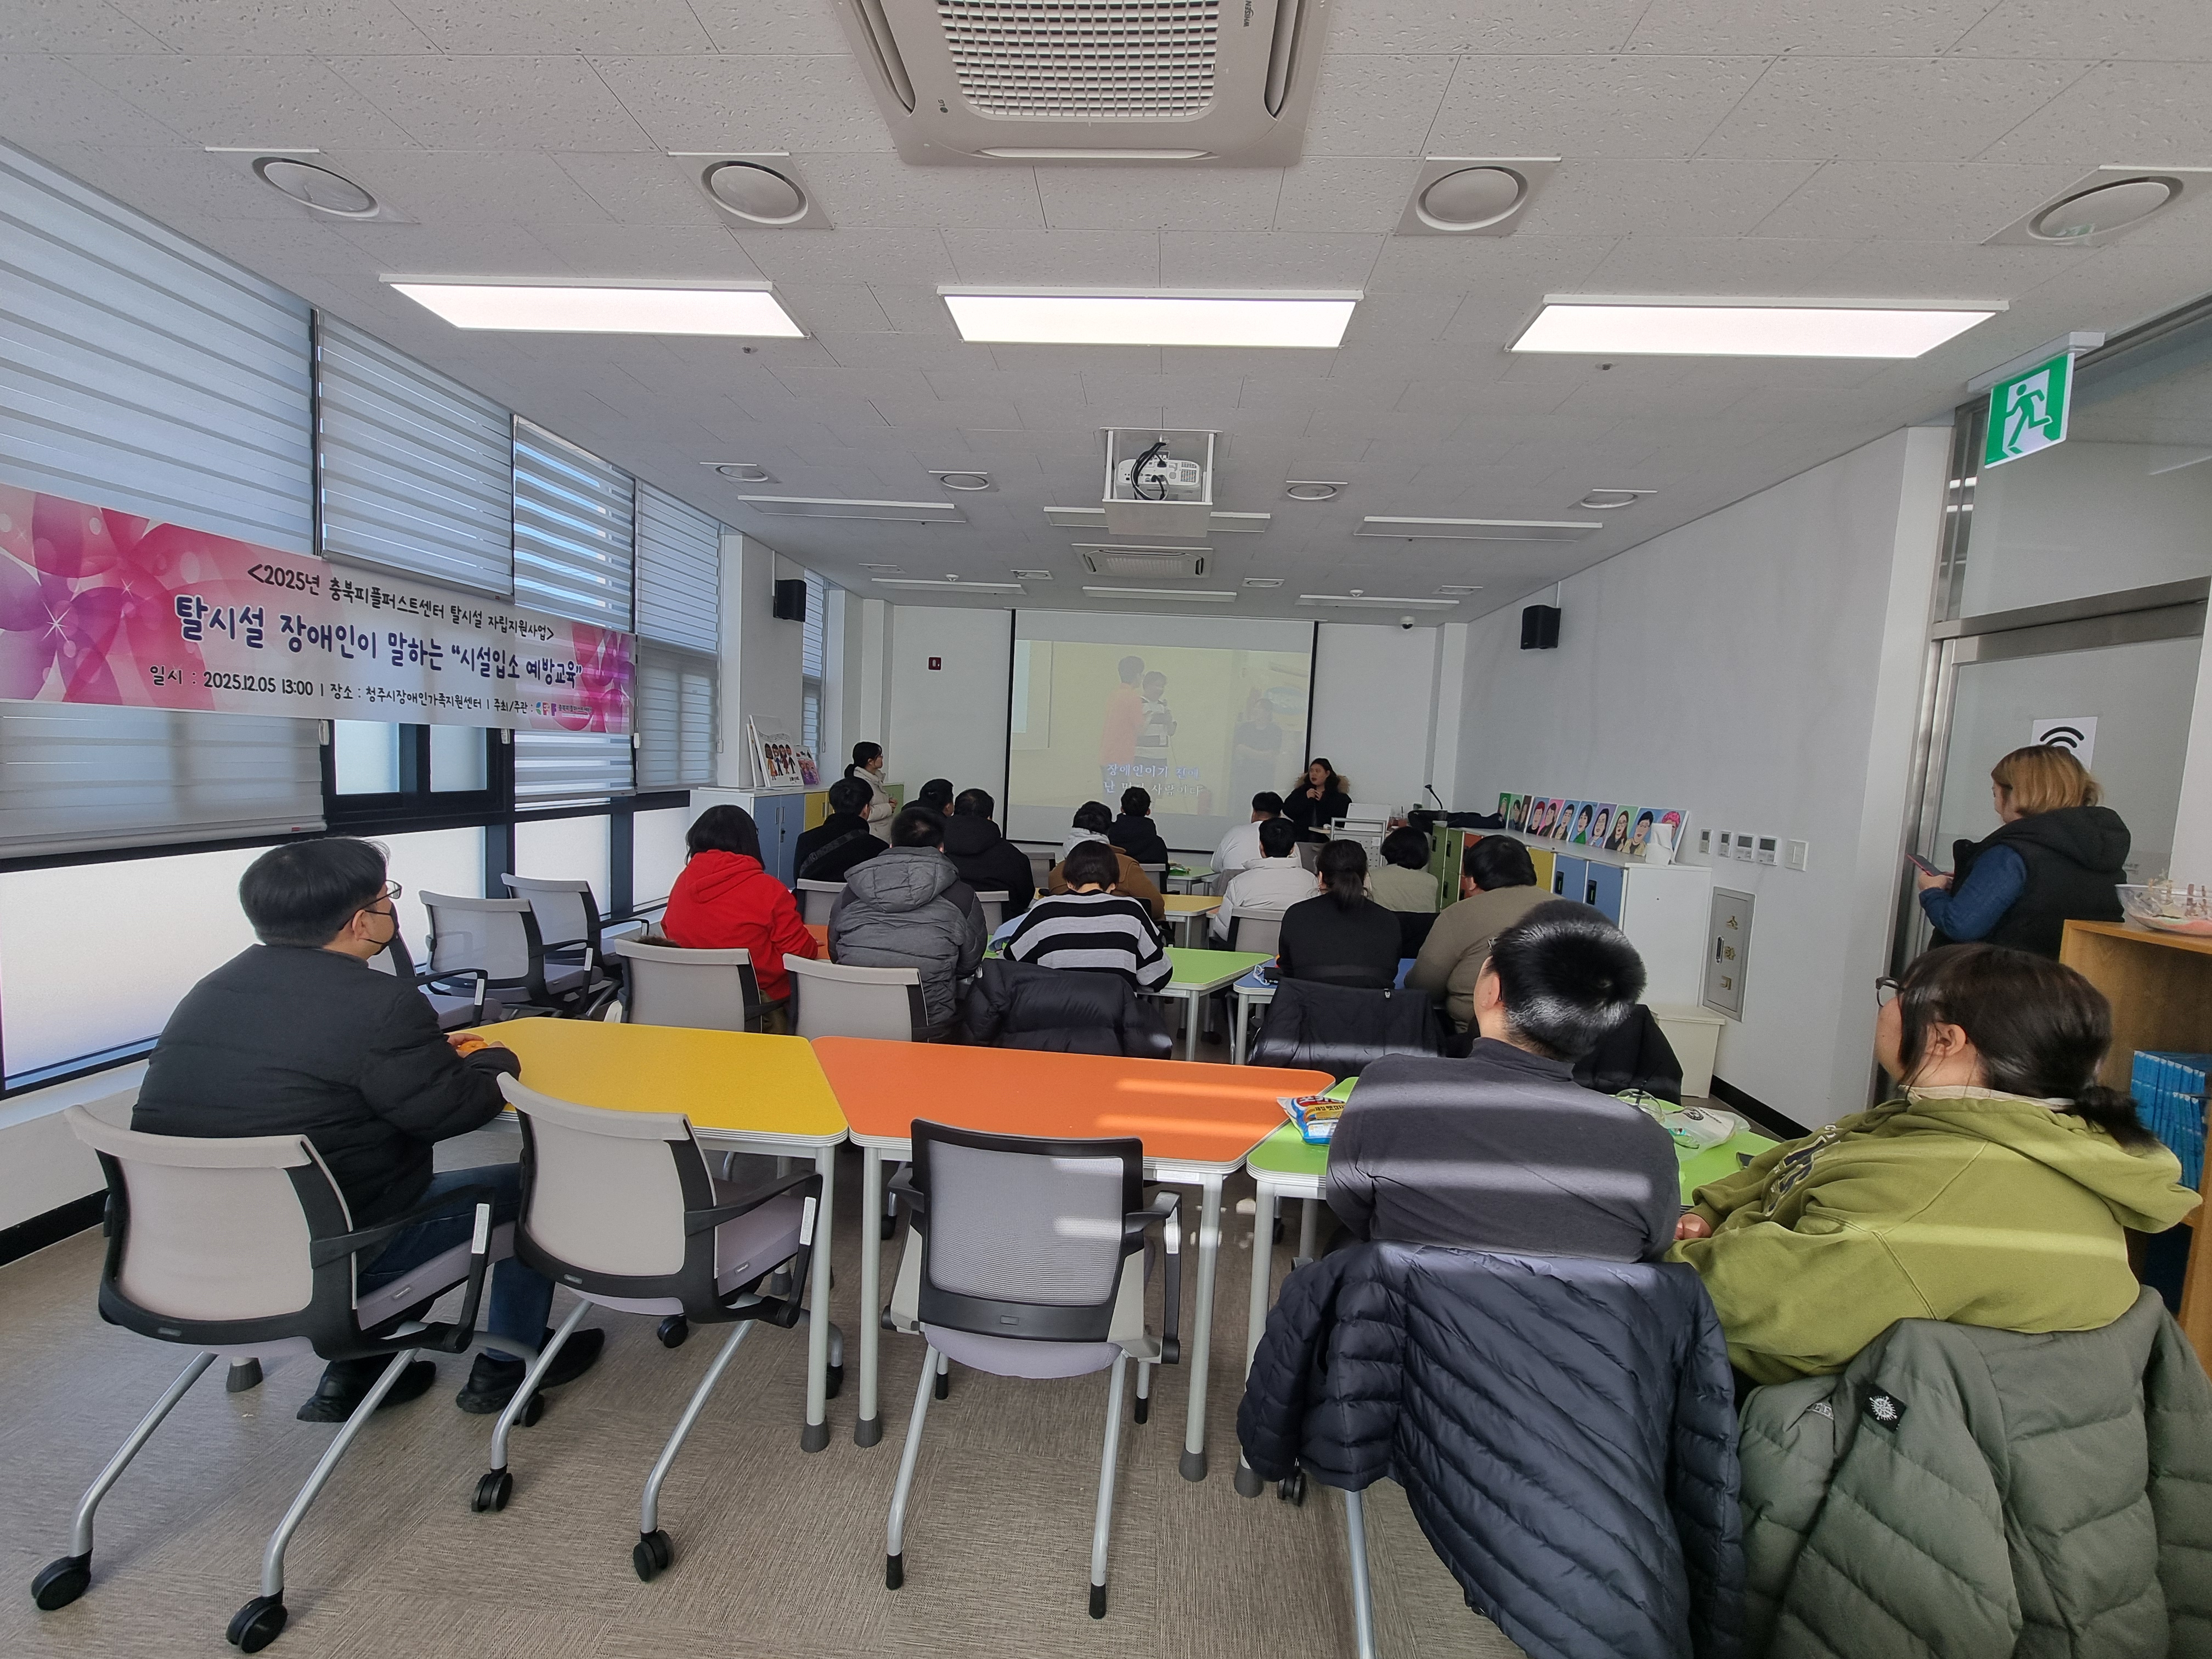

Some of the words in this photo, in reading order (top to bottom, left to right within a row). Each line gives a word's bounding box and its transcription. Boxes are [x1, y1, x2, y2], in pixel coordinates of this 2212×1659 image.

[1243, 0, 1254, 27] WHISEN
[247, 563, 320, 596] <2025년
[329, 577, 444, 619] 충북피플퍼스트센터
[450, 605, 482, 628] 탈시설
[488, 616, 554, 641] 자립지원사업>
[176, 596, 264, 648] 탈시설
[280, 614, 376, 659] 장애인이
[388, 632, 443, 671] 말하는
[150, 665, 182, 686] 일시
[204, 672, 276, 692] 2025.12.05
[282, 679, 313, 696] 13:00
[330, 683, 353, 699] 장소
[365, 686, 482, 709] 청주시장애인가족지원센터
[494, 698, 528, 714] 주최/주관
[1104, 780, 1115, 793] 난
[1107, 763, 1169, 778] 장애인이기
